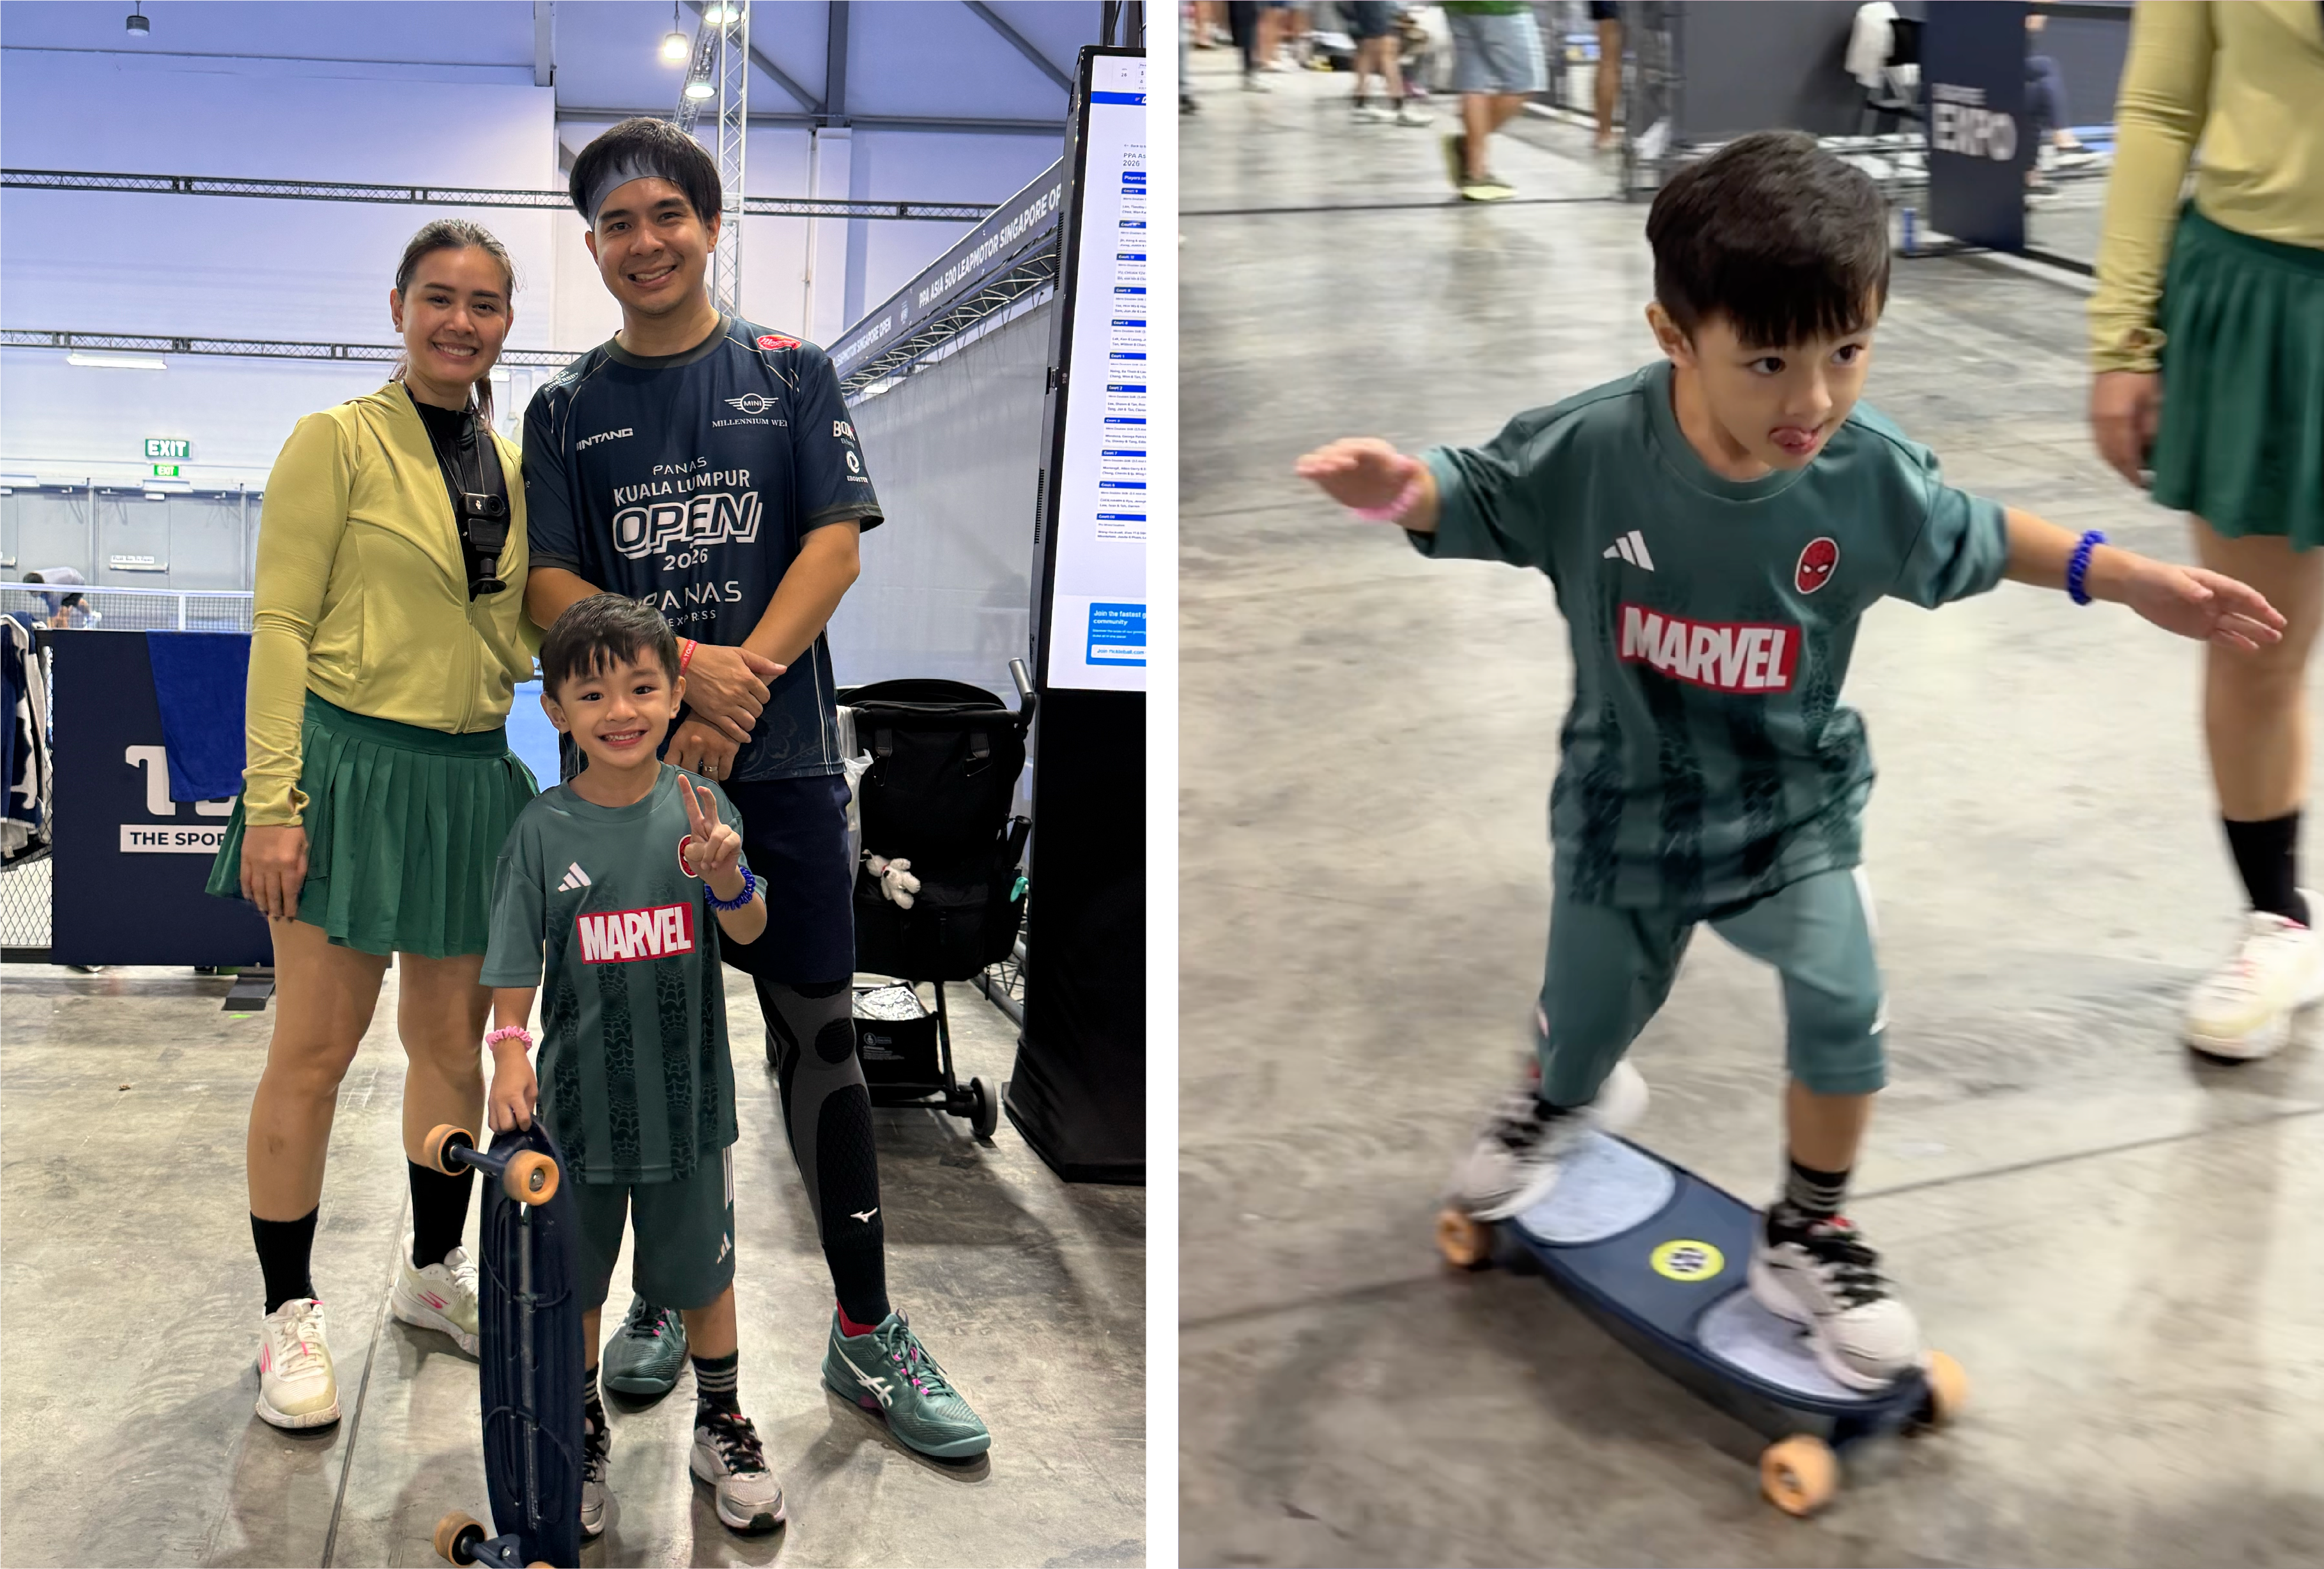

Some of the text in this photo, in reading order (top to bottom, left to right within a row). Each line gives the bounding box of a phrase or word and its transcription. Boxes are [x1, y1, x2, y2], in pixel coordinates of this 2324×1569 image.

[919, 287, 929, 308] PPA
[930, 277, 943, 302] ASIA
[944, 269, 956, 290] 500
[957, 234, 999, 281] LEAPMOTOR
[999, 194, 1047, 249] SINGAPORE
[712, 418, 769, 428] MILLENNIUM
[147, 440, 187, 457] EXIT
[157, 466, 175, 475] EXIT
[653, 456, 707, 475] PANAS
[613, 469, 750, 507] KUALA LUMPUR
[612, 491, 763, 560] OPEN
[663, 548, 708, 571] 2026
[668, 609, 716, 627] EXPRSS
[1622, 606, 1787, 688] MARVEL
[130, 832, 169, 845] THE
[579, 906, 691, 961] MARVEL
